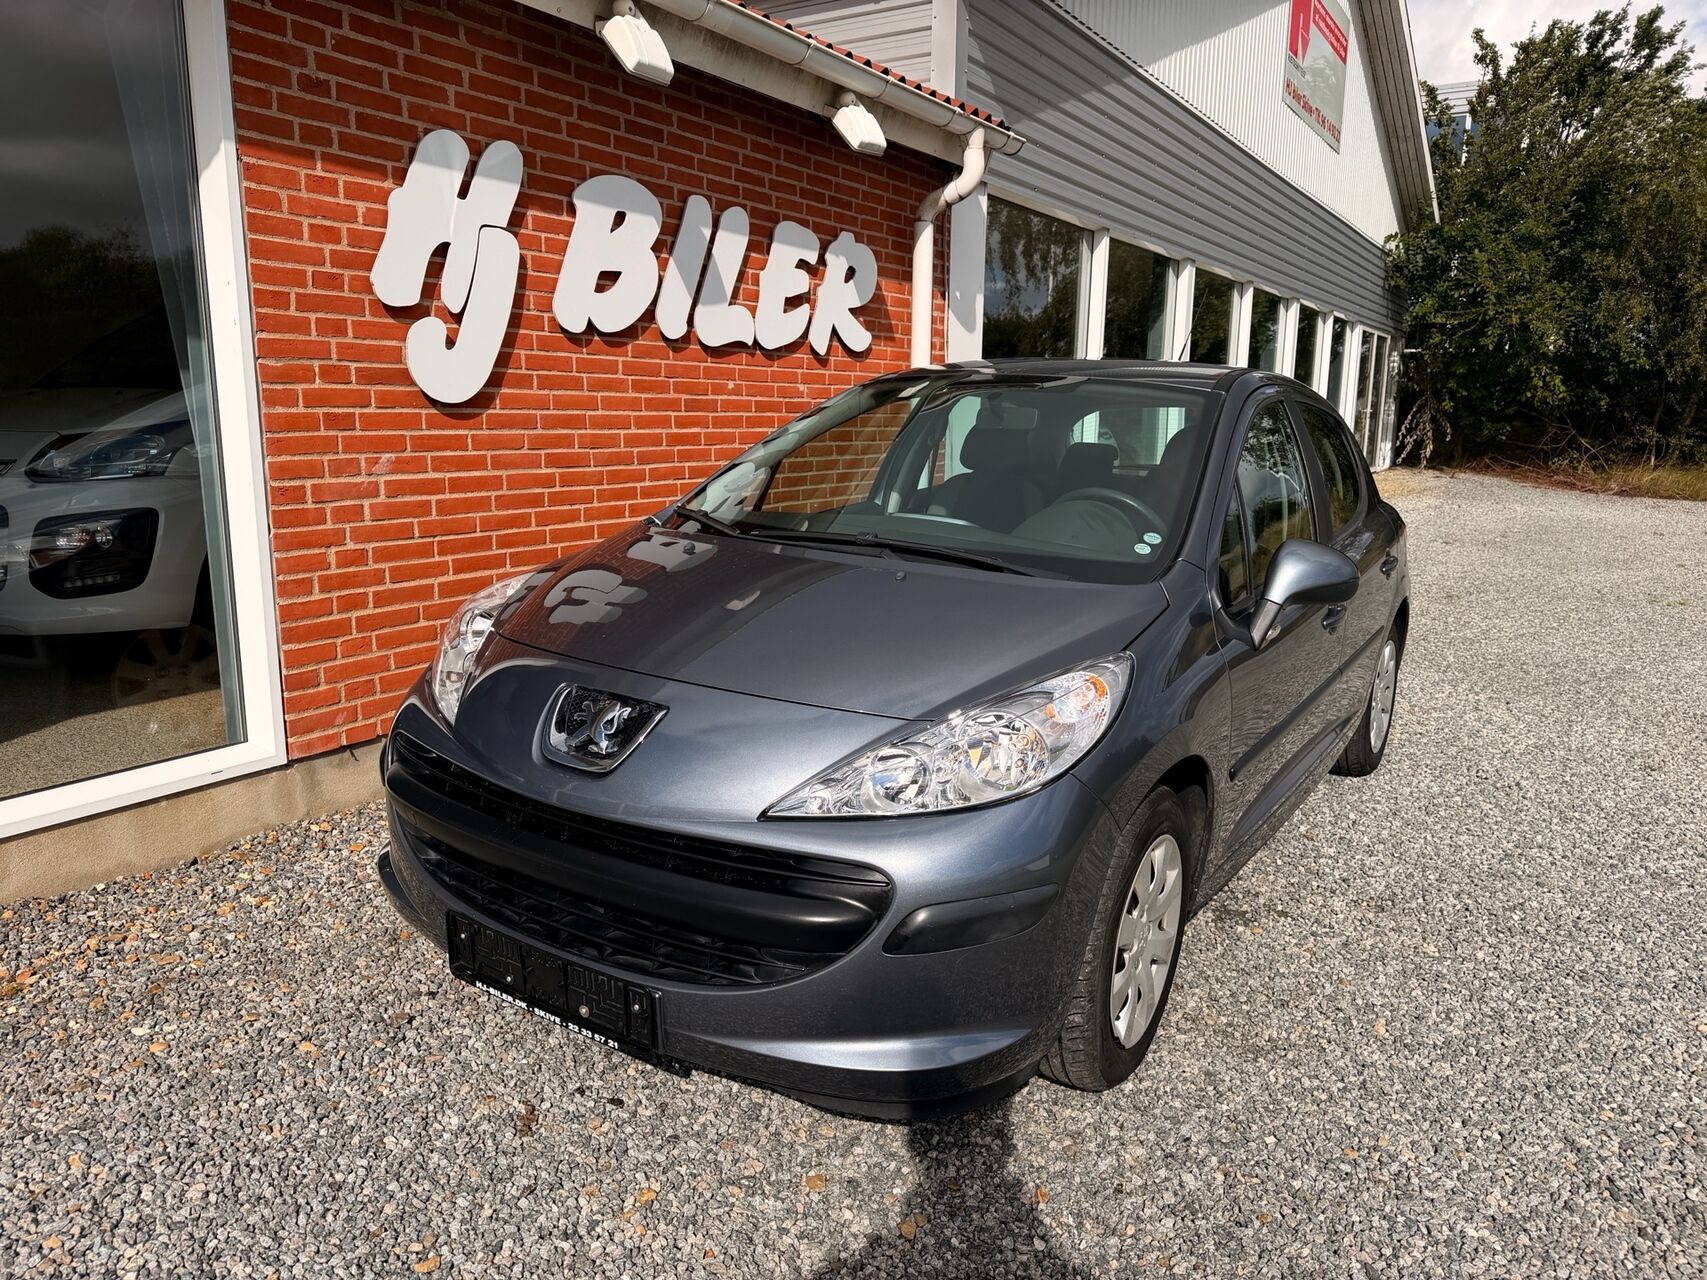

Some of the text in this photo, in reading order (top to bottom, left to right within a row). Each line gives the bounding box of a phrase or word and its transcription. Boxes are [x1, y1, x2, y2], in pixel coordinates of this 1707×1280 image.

[1302, 94, 1313, 117] Skive
[553, 174, 879, 357] BILER
[475, 980, 528, 1010] HJ-BILER.DK
[534, 1007, 561, 1025] SKIVE
[567, 1022, 580, 1033] 22
[580, 1028, 593, 1038] 33
[594, 1033, 606, 1043] 57
[607, 1039, 619, 1050] 21
